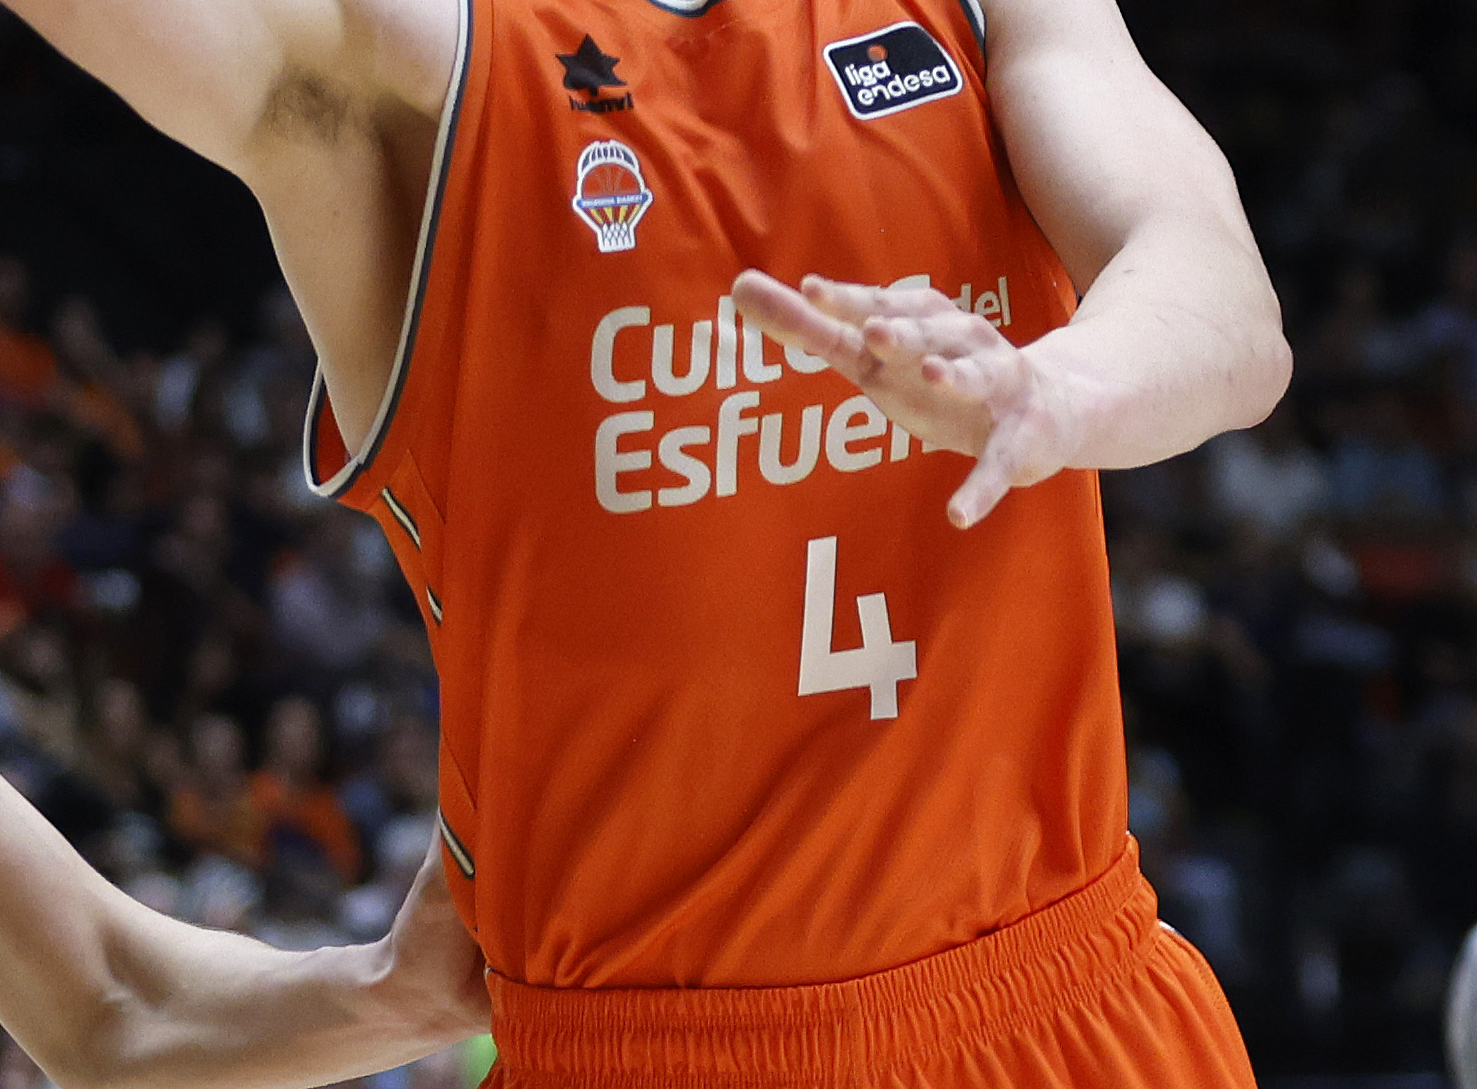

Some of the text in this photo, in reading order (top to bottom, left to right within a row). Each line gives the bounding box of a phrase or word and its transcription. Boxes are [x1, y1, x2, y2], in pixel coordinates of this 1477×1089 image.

[844, 60, 891, 87] liga
[857, 64, 951, 106] endesa
[798, 535, 918, 720] 4
